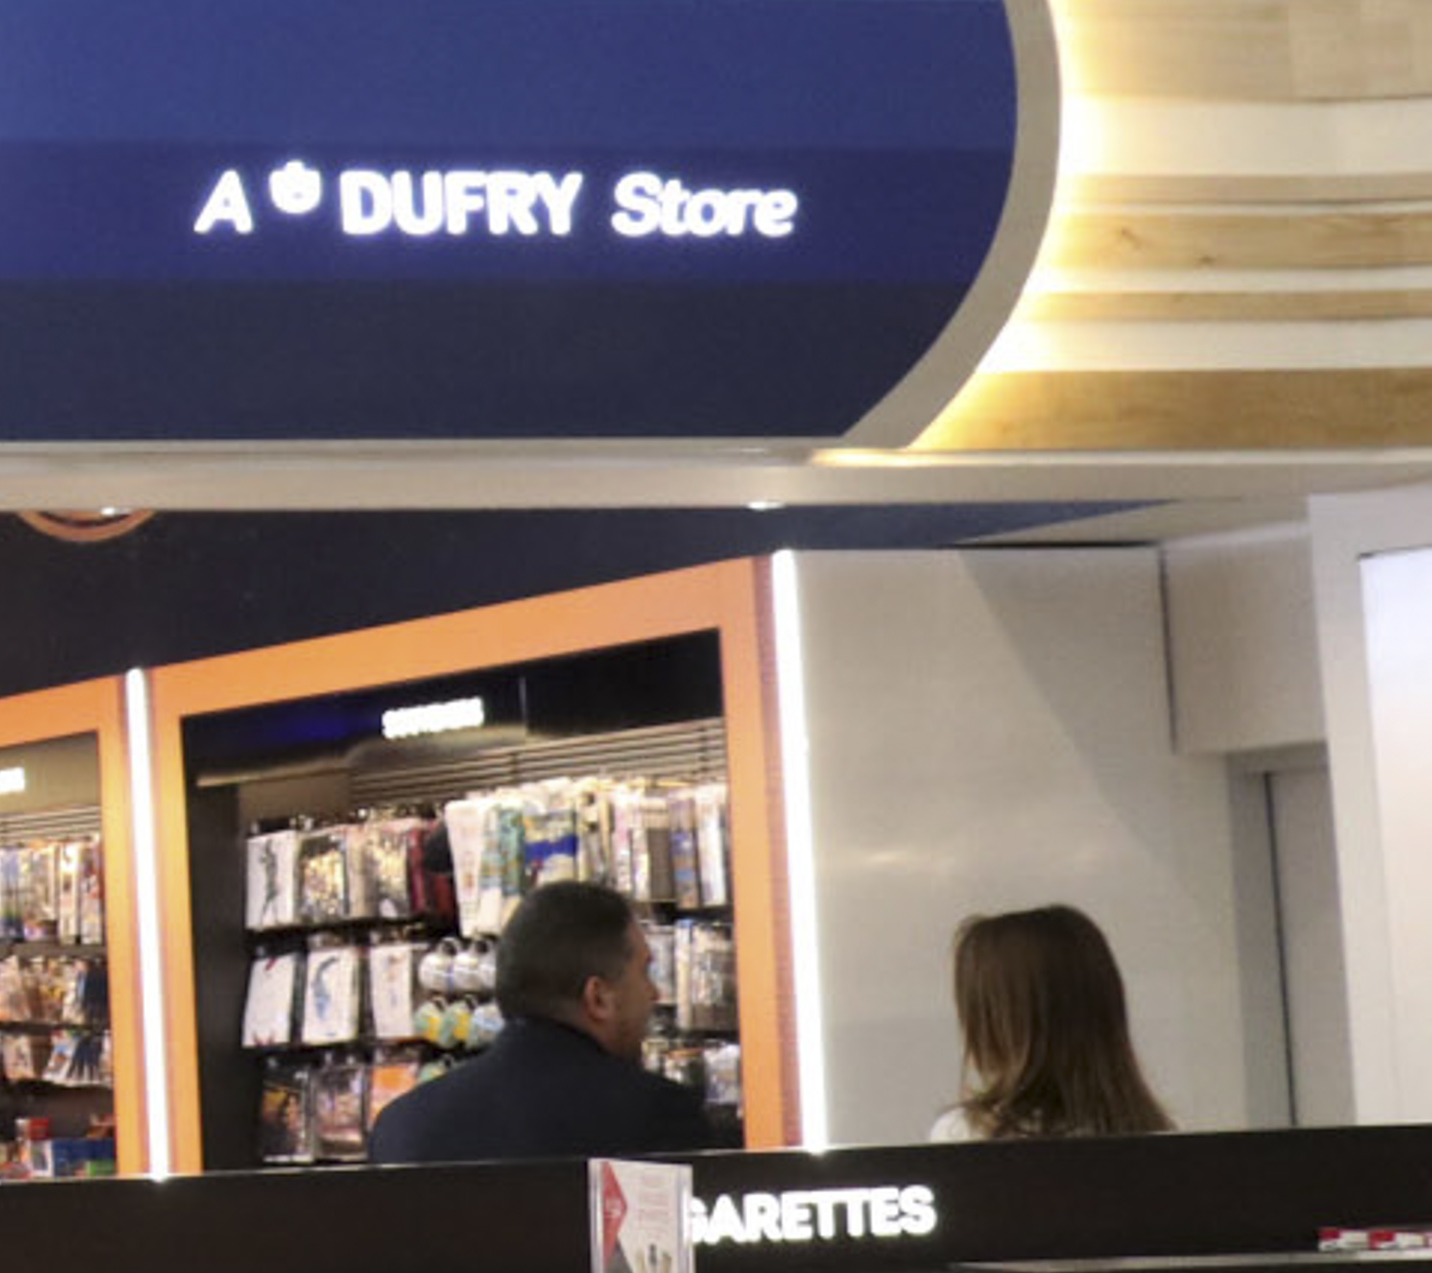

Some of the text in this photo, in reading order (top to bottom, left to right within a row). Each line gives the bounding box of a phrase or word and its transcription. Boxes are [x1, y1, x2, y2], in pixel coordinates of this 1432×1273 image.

[193, 168, 799, 239] A DUFRY Store
